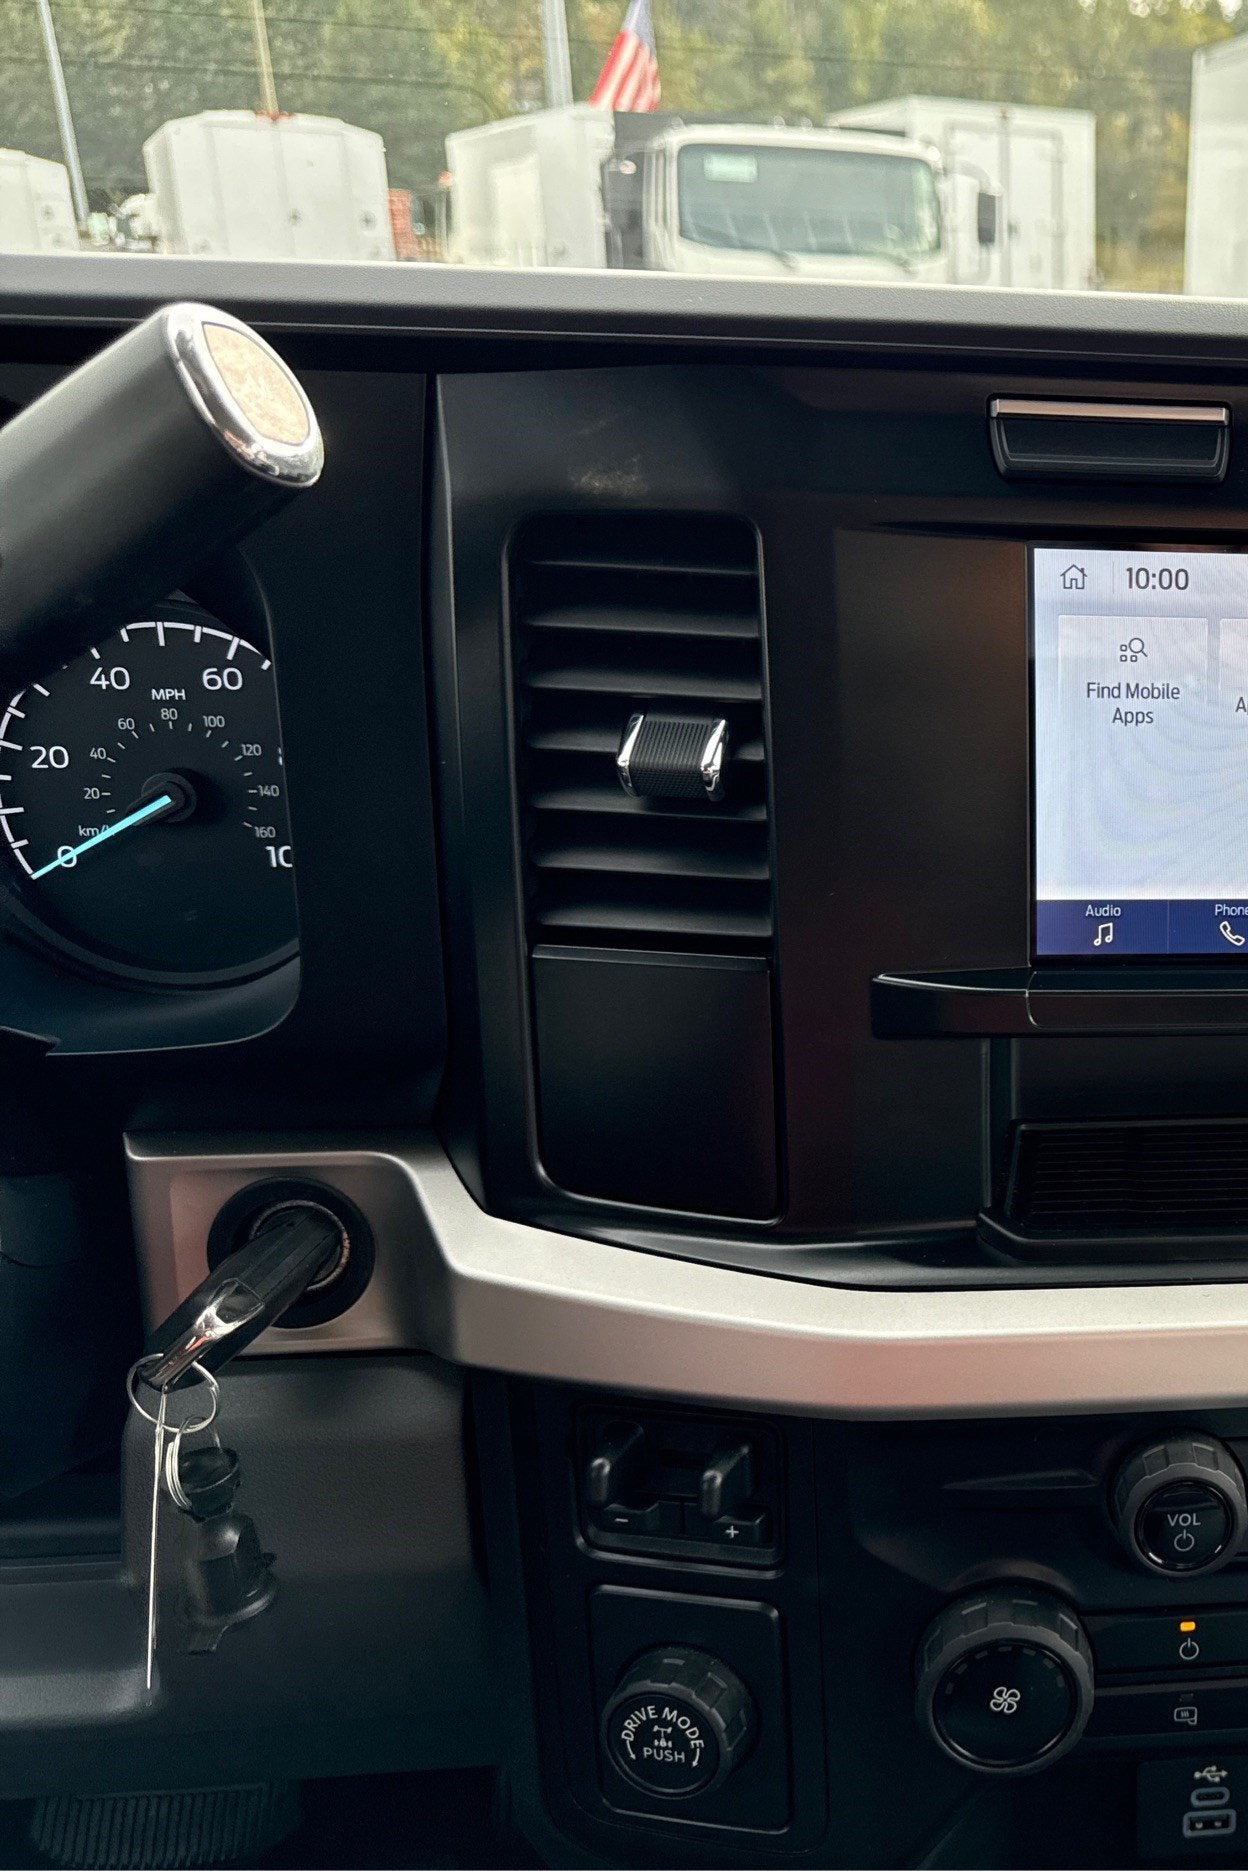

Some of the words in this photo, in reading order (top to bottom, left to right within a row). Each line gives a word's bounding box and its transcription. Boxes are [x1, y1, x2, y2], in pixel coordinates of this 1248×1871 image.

[1125, 567, 1190, 592] 10:00
[89, 666, 131, 690] 40
[202, 667, 243, 690] 60
[151, 689, 186, 701] MPH
[1085, 682, 1121, 701] Find
[1124, 682, 1181, 701] Mobile
[160, 708, 178, 721] 80
[202, 715, 226, 728] 100
[1112, 707, 1154, 728] Apps
[117, 718, 136, 731] 60
[89, 747, 107, 760] 40
[241, 743, 263, 756] 120
[29, 745, 70, 769] 20
[83, 788, 101, 800] 20
[257, 785, 280, 797] 140
[254, 826, 277, 838] 160
[57, 845, 78, 868] 0
[1085, 904, 1122, 917] Audio
[1166, 1512, 1202, 1527] VOL
[621, 1705, 658, 1742] DRIVE
[662, 1707, 705, 1748] MODE
[643, 1747, 686, 1763] PUSH
